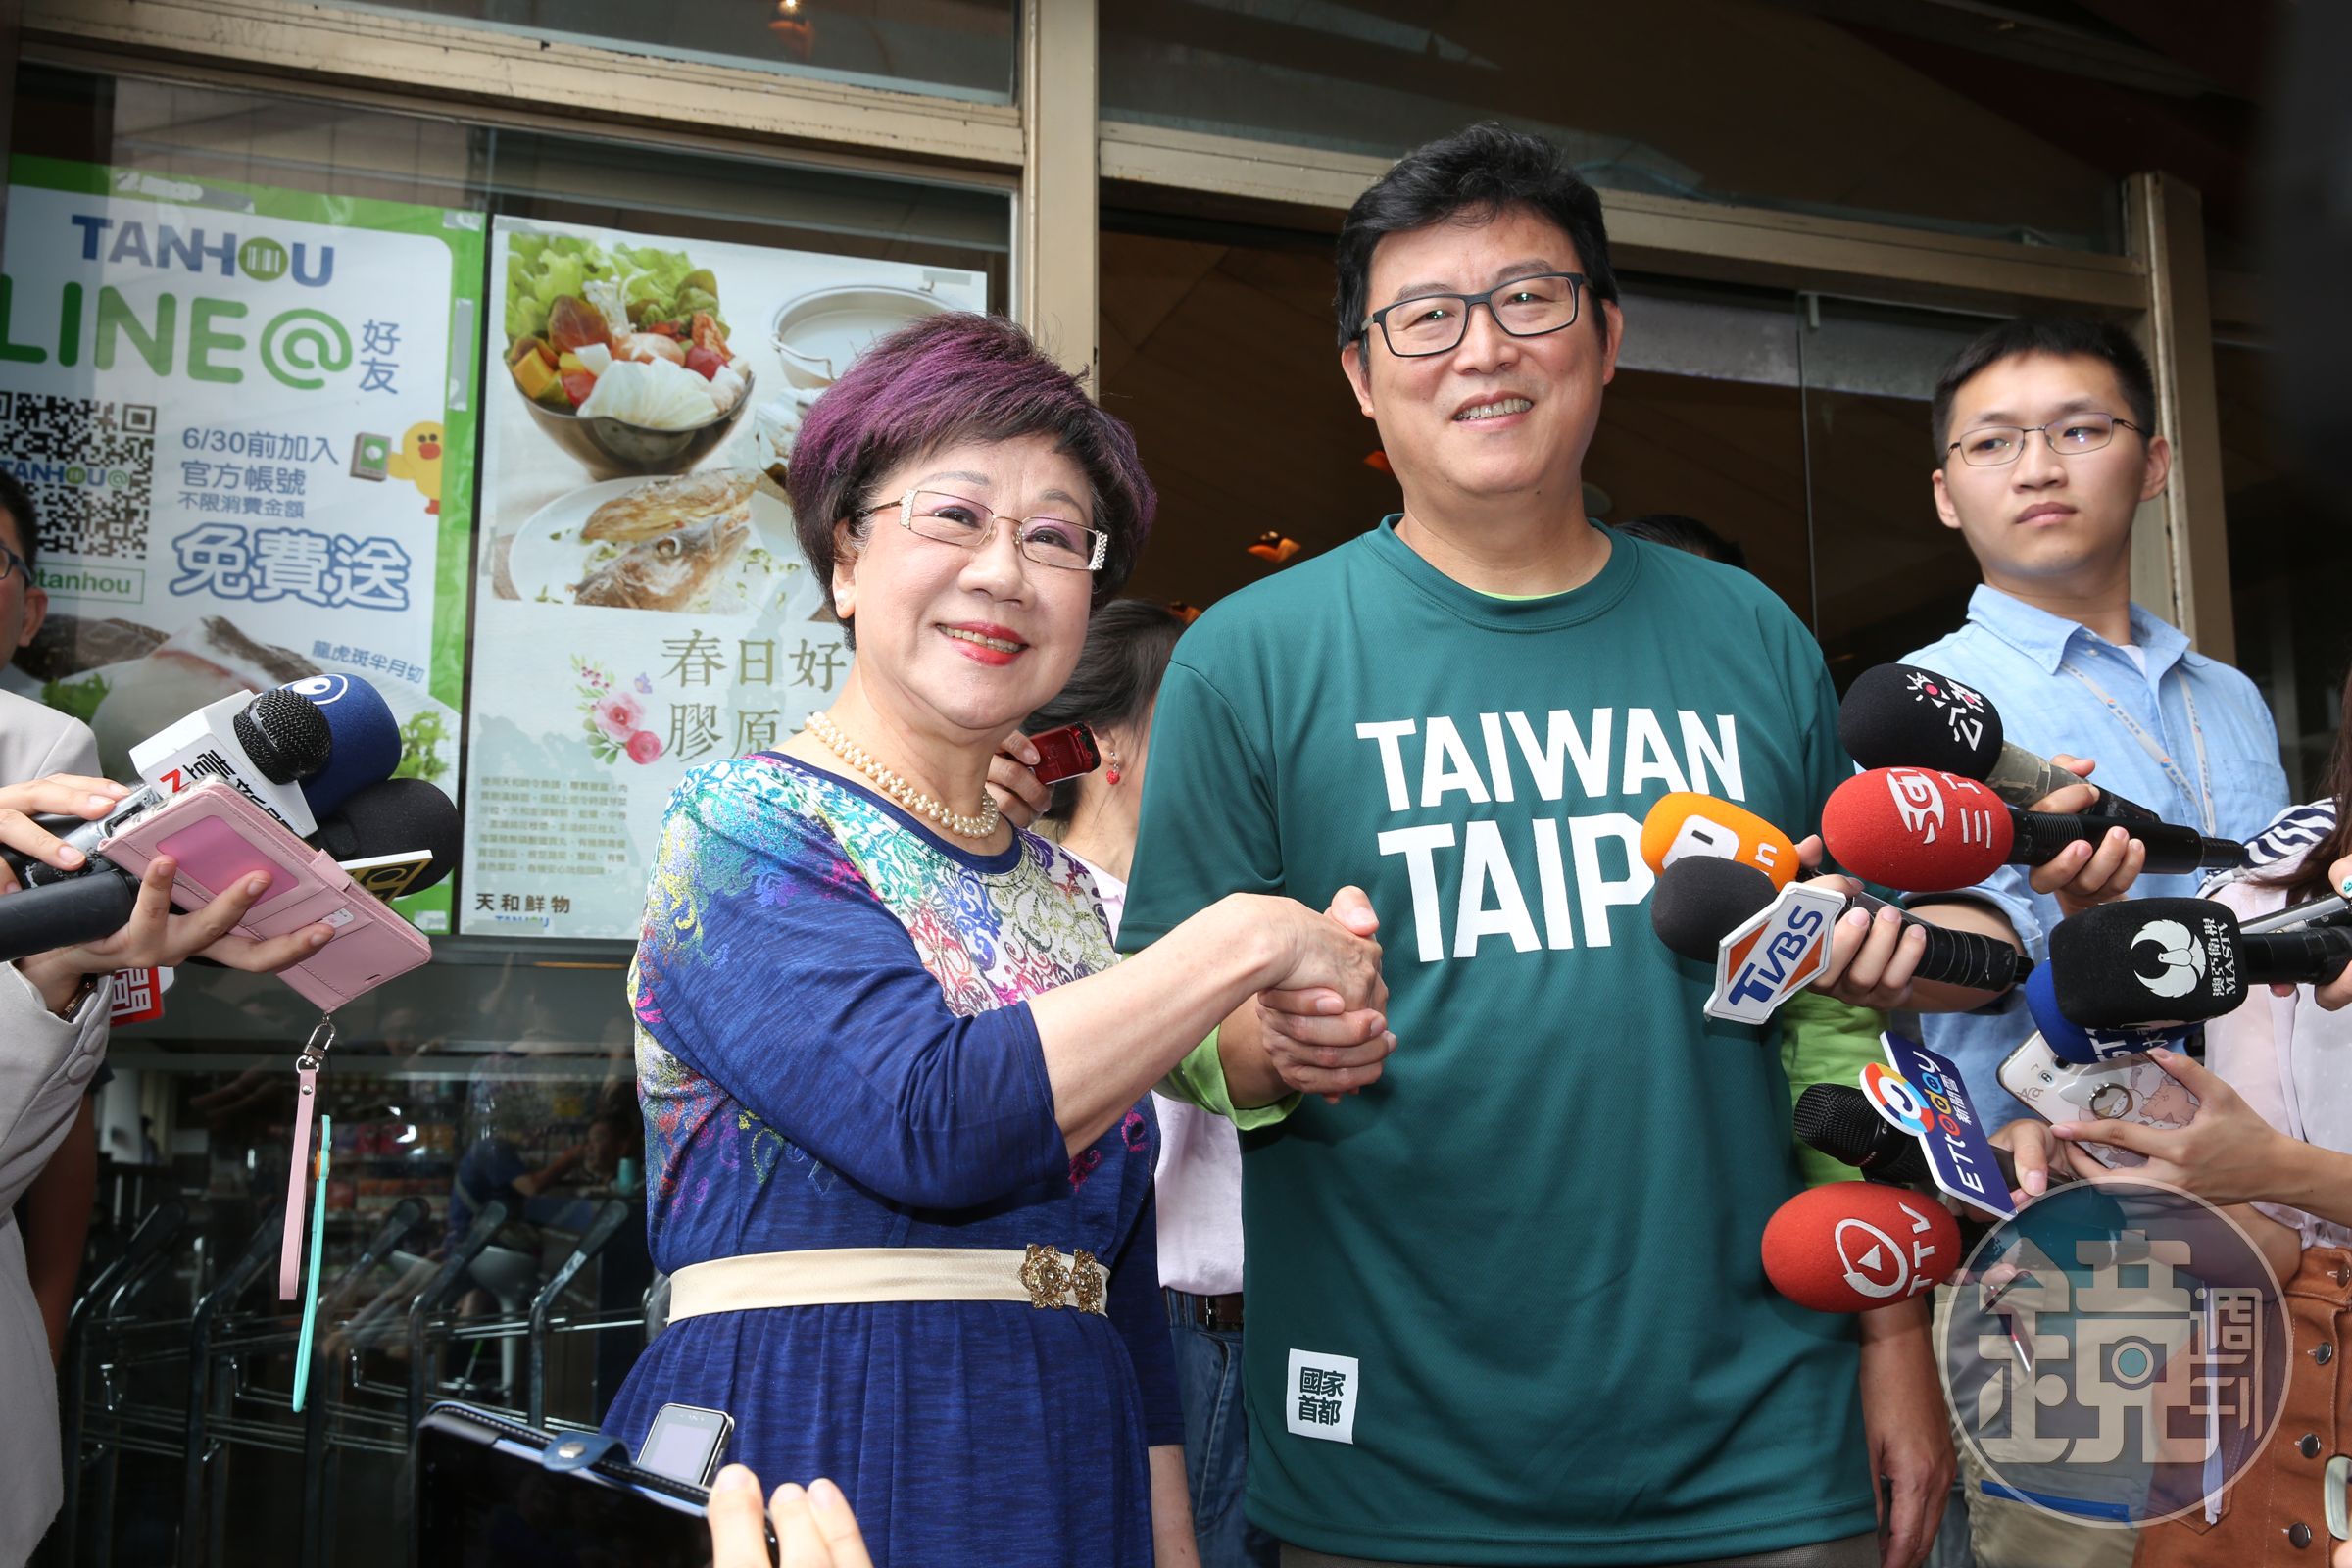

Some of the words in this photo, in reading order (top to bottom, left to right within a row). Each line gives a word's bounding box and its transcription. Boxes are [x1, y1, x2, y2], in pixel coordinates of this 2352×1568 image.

[359, 319, 401, 394] 好友
[182, 427, 339, 465] 6/30前加入
[177, 491, 305, 520] 不限消費金額
[180, 460, 306, 496] 官方帳號
[33, 566, 131, 594] tanhou
[170, 523, 411, 611] 免費送
[660, 702, 821, 763] 膠原
[1355, 707, 1745, 812] TAIWAN
[475, 893, 571, 913] 天和鮮物
[1377, 812, 1656, 963] TAIP
[1728, 905, 1823, 1005] TVBS
[1912, 1050, 1985, 1195] ETtoday
[1898, 1201, 1936, 1297] TTV
[1298, 1394, 1343, 1427] 首都
[1299, 1366, 1347, 1397] 國家
